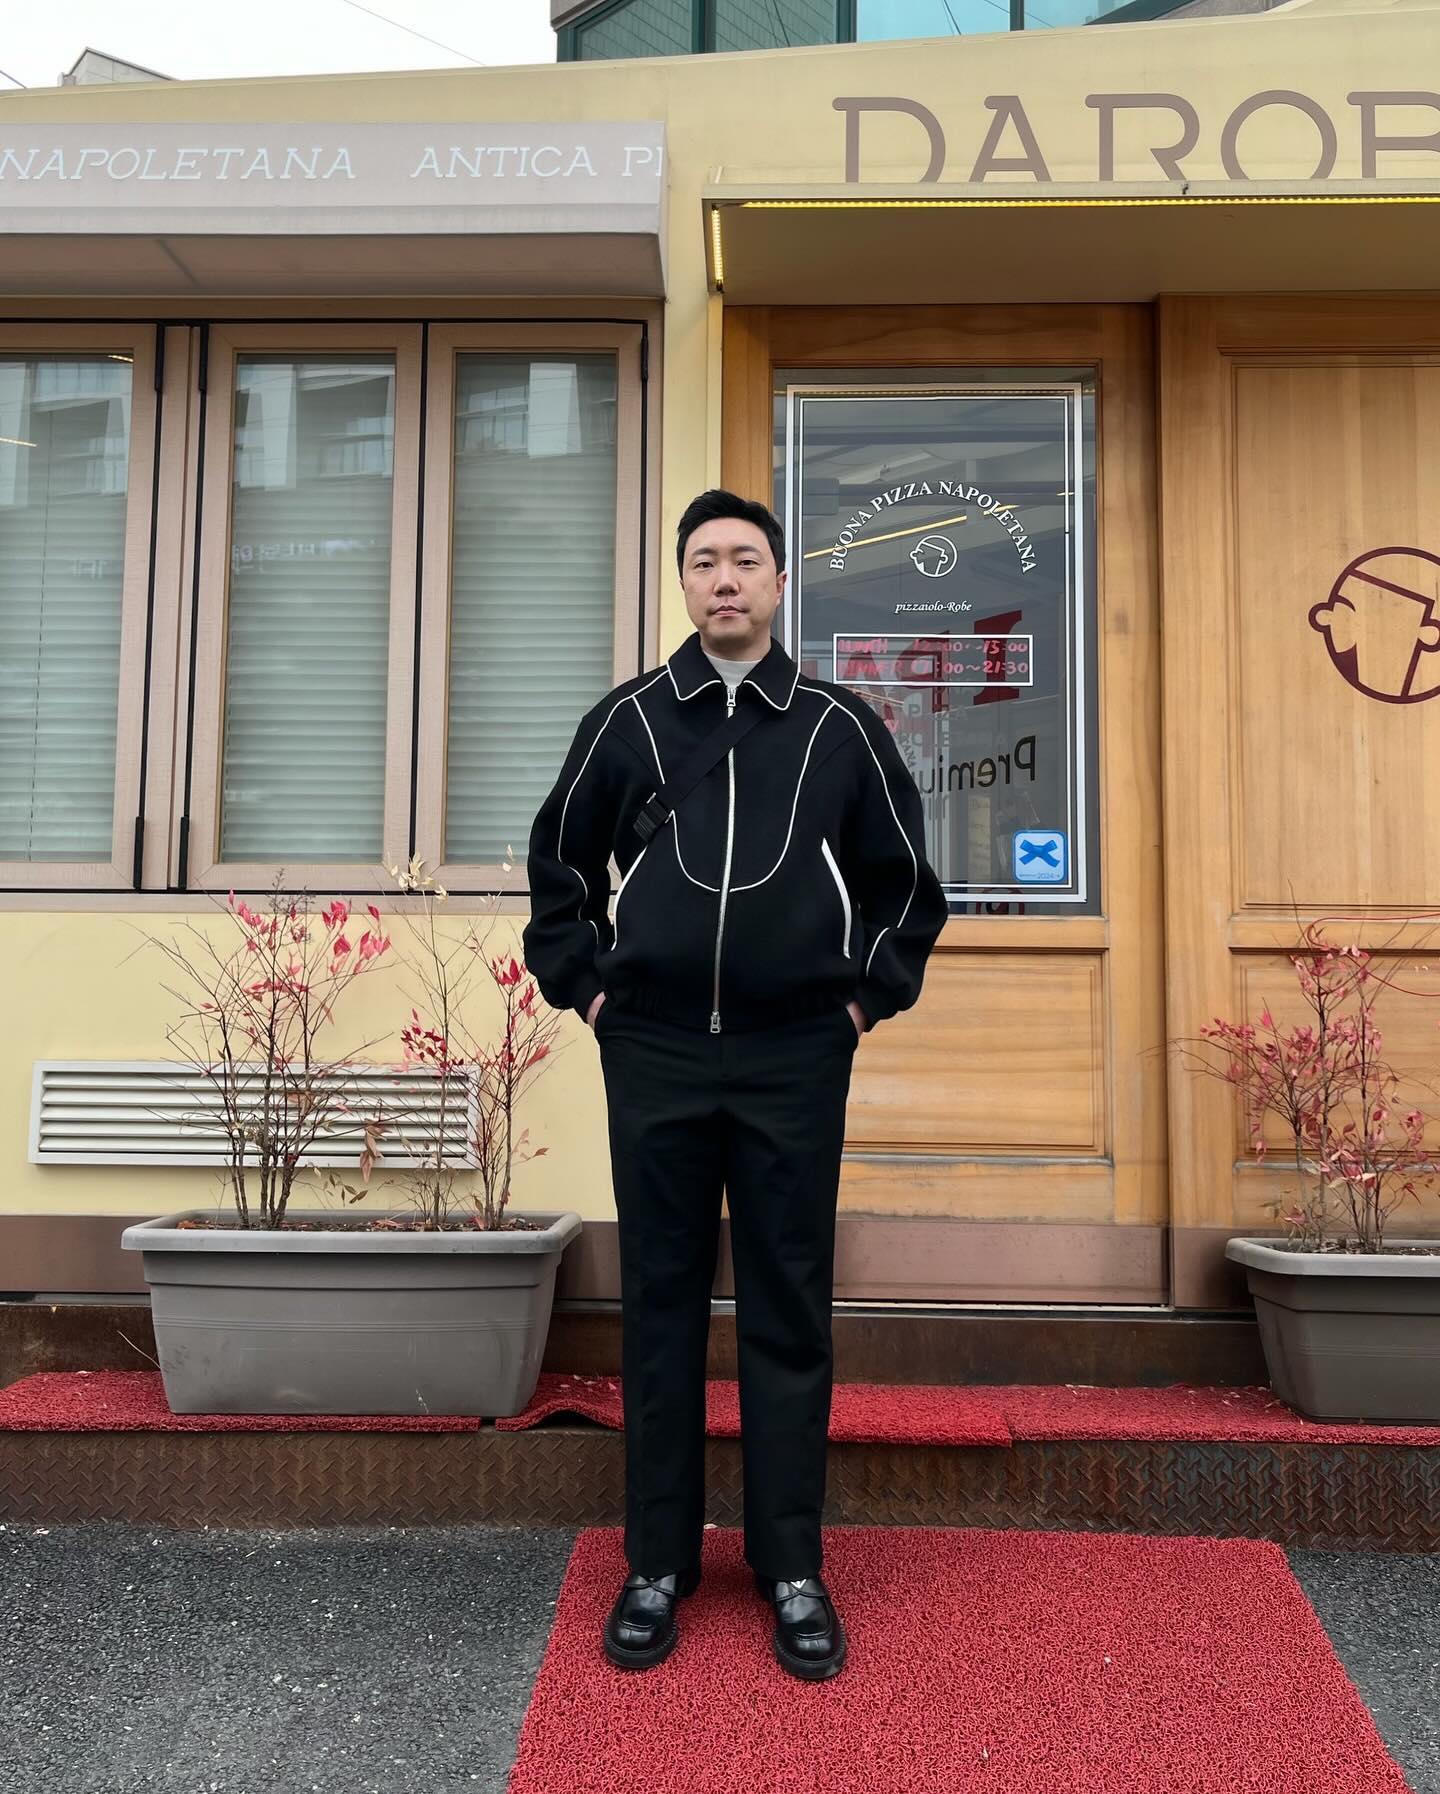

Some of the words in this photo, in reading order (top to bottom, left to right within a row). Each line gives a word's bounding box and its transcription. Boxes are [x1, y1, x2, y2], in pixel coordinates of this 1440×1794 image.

[0, 147, 356, 180] NAPOLETANA
[409, 146, 598, 179] ANTICA
[829, 510, 874, 571] BUONA
[870, 481, 933, 512] PIZZA
[938, 481, 1037, 574] NAPOLETANA
[894, 600, 972, 614] pizzaiolo-Robe
